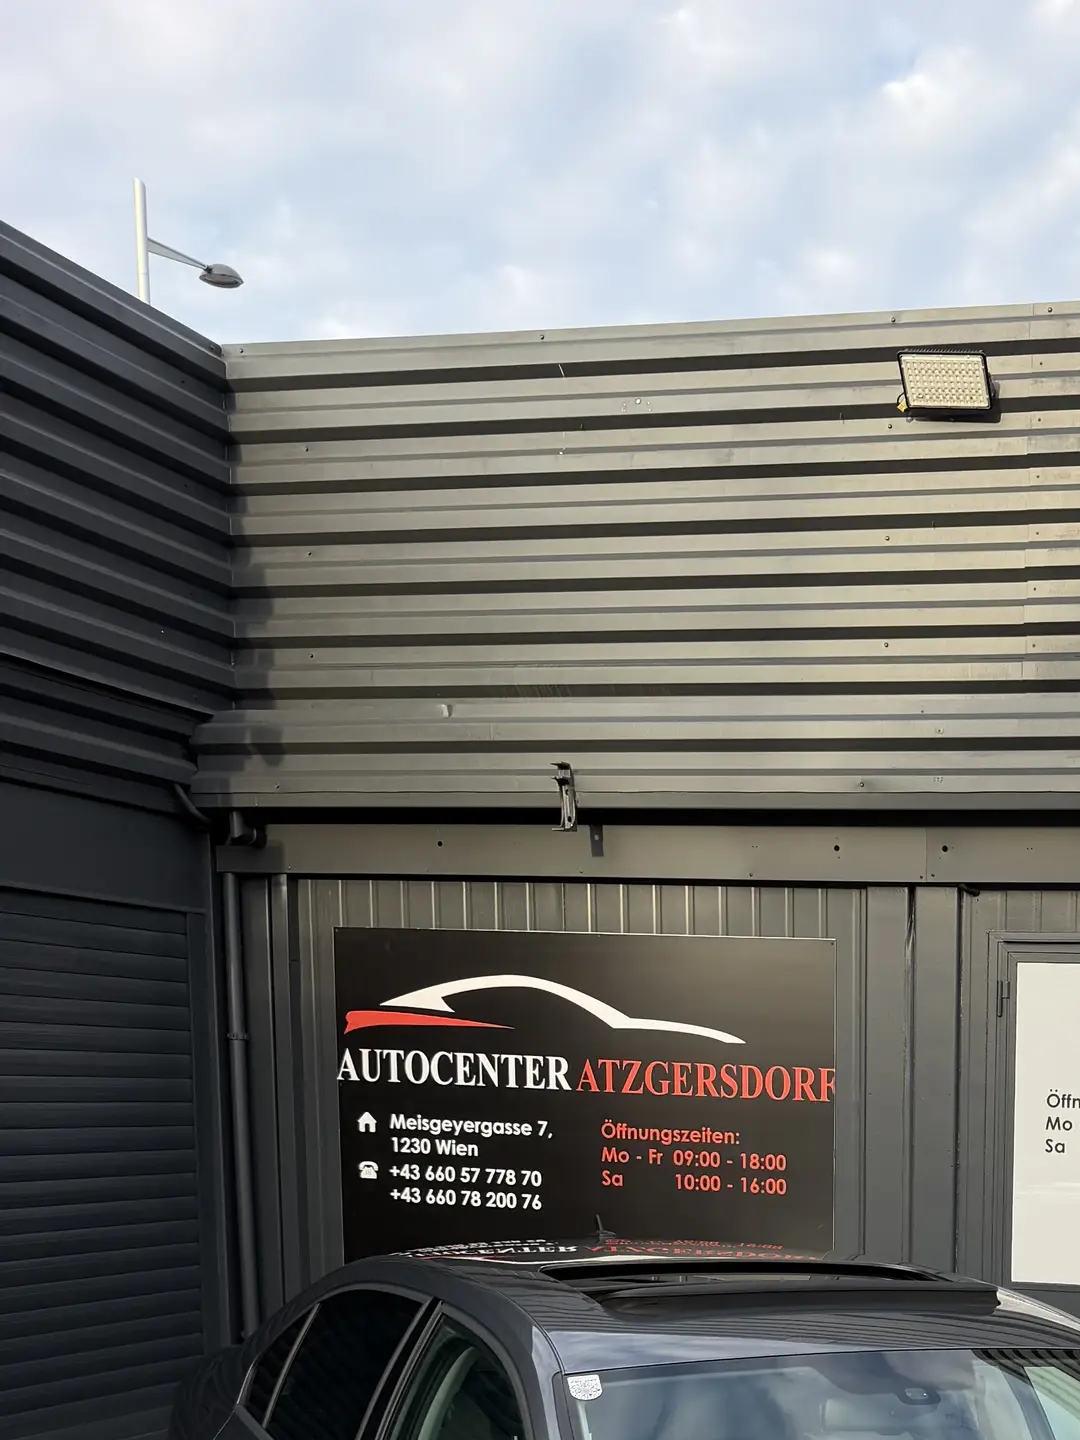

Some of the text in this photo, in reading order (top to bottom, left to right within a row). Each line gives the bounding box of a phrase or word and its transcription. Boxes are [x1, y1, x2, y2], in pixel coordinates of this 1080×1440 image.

[336, 1047, 835, 1103] AUTOCENTER ATZGERSDORF
[389, 1113, 553, 1139] Meisgeyergasse 7,
[600, 1119, 741, 1146] Öffnungszeiten:
[1045, 1116, 1073, 1132] Mo
[391, 1136, 479, 1157] 1230 Wien
[1045, 1138, 1065, 1154] Sa
[601, 1146, 630, 1164] Mo
[648, 1148, 663, 1165] Fr
[672, 1149, 721, 1168] 09:00
[739, 1152, 787, 1172] 18:00
[388, 1163, 543, 1187] +43 660 57 778 70
[601, 1169, 624, 1187] Sa
[675, 1173, 721, 1192] 10:00
[740, 1176, 787, 1196] 16:00
[389, 1186, 542, 1211] +43 660 78 200 76
